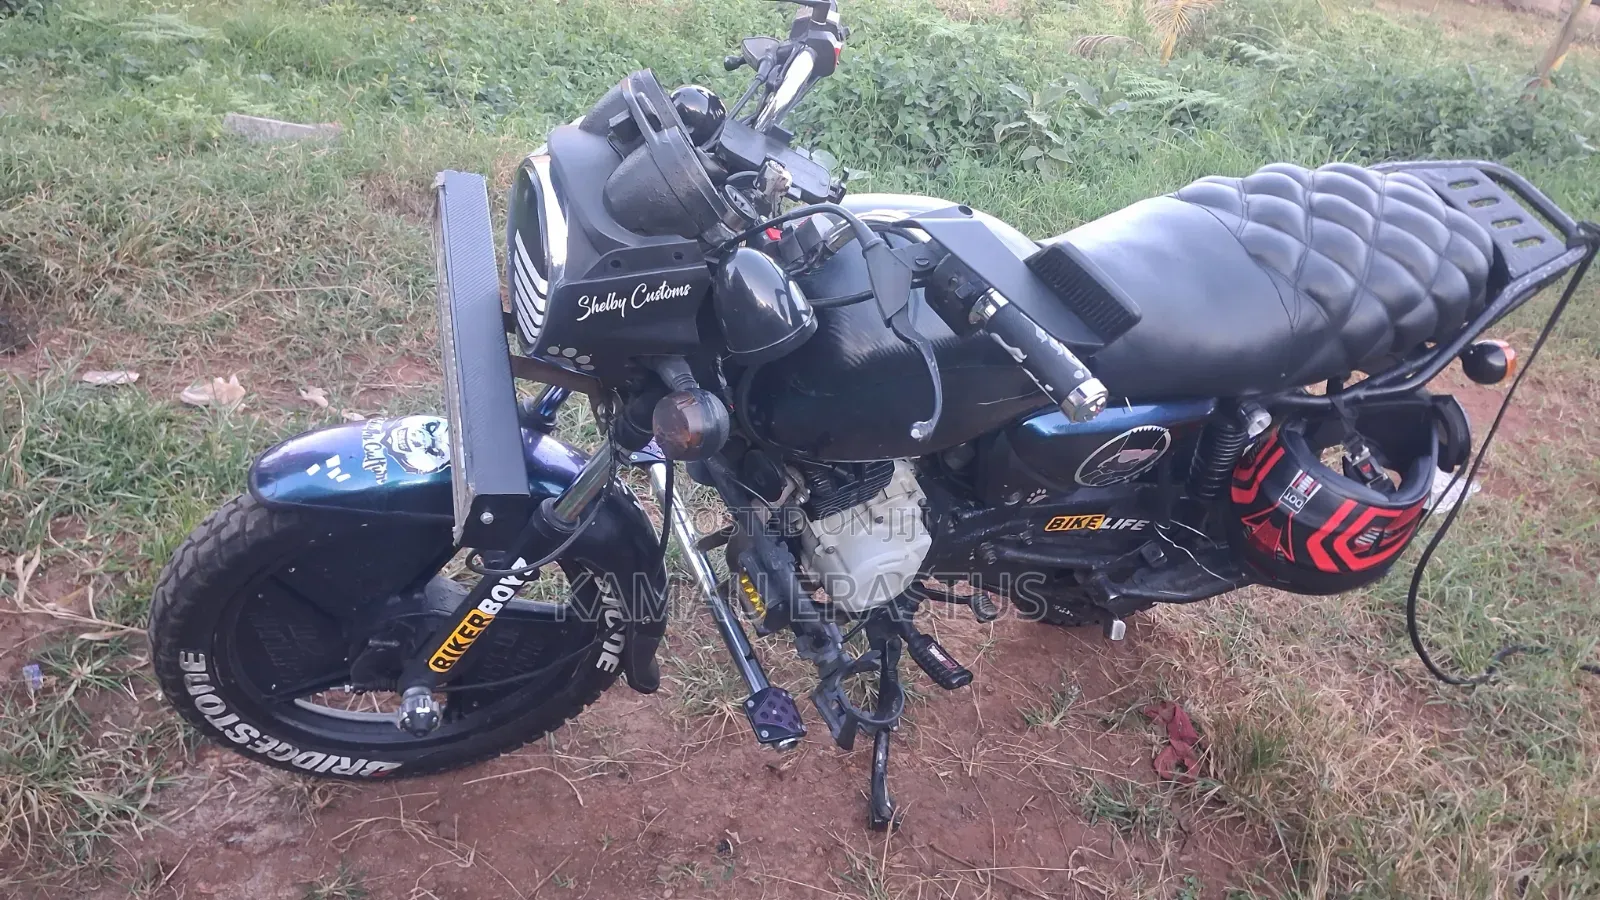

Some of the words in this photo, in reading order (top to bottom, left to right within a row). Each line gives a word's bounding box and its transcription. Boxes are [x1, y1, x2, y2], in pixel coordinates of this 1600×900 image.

[576, 291, 627, 321] Shelby
[631, 280, 691, 309] Customs
[1283, 492, 1304, 509] DOT
[179, 650, 404, 777] BRIDGESTONE
